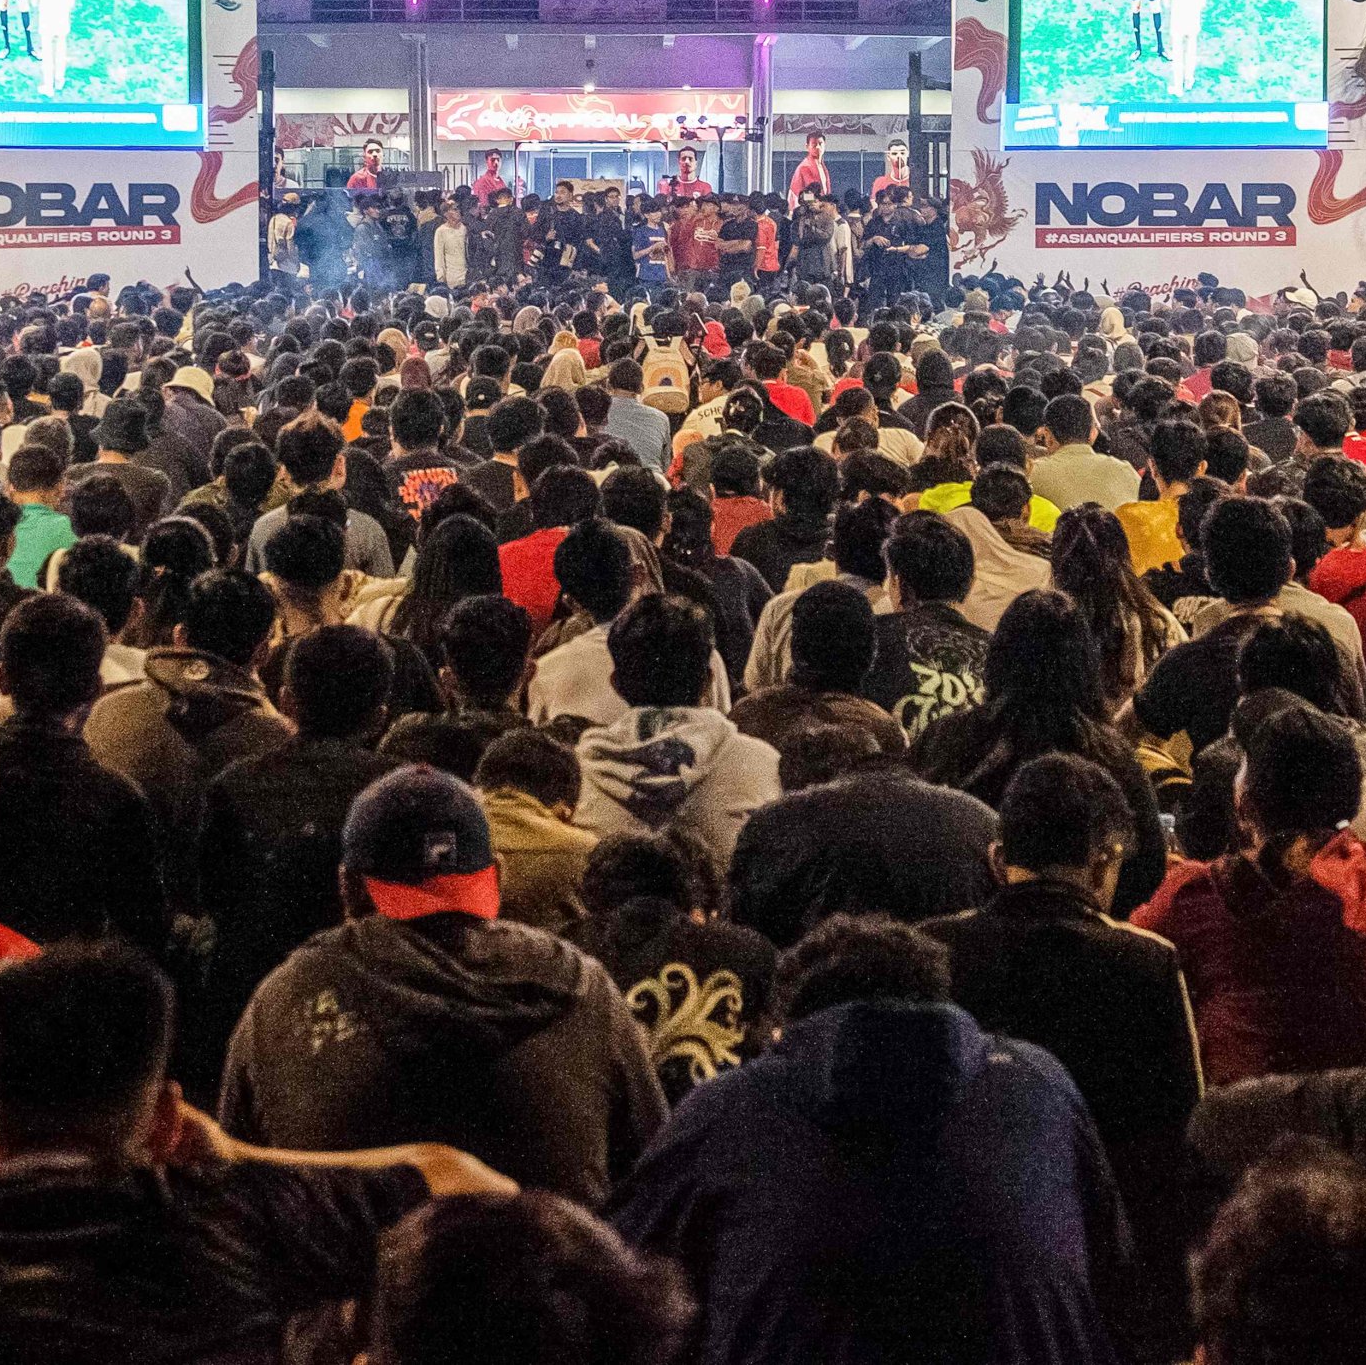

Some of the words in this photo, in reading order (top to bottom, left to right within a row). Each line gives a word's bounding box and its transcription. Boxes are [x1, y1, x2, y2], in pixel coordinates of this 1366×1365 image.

[1035, 181, 1296, 227] NOBAR
[97, 230, 156, 242] ROUND
[160, 229, 172, 240] 3
[1044, 231, 1204, 245] #ASIANQUALIFIERS
[1209, 231, 1271, 243] ROUND
[1274, 231, 1287, 242] 3
